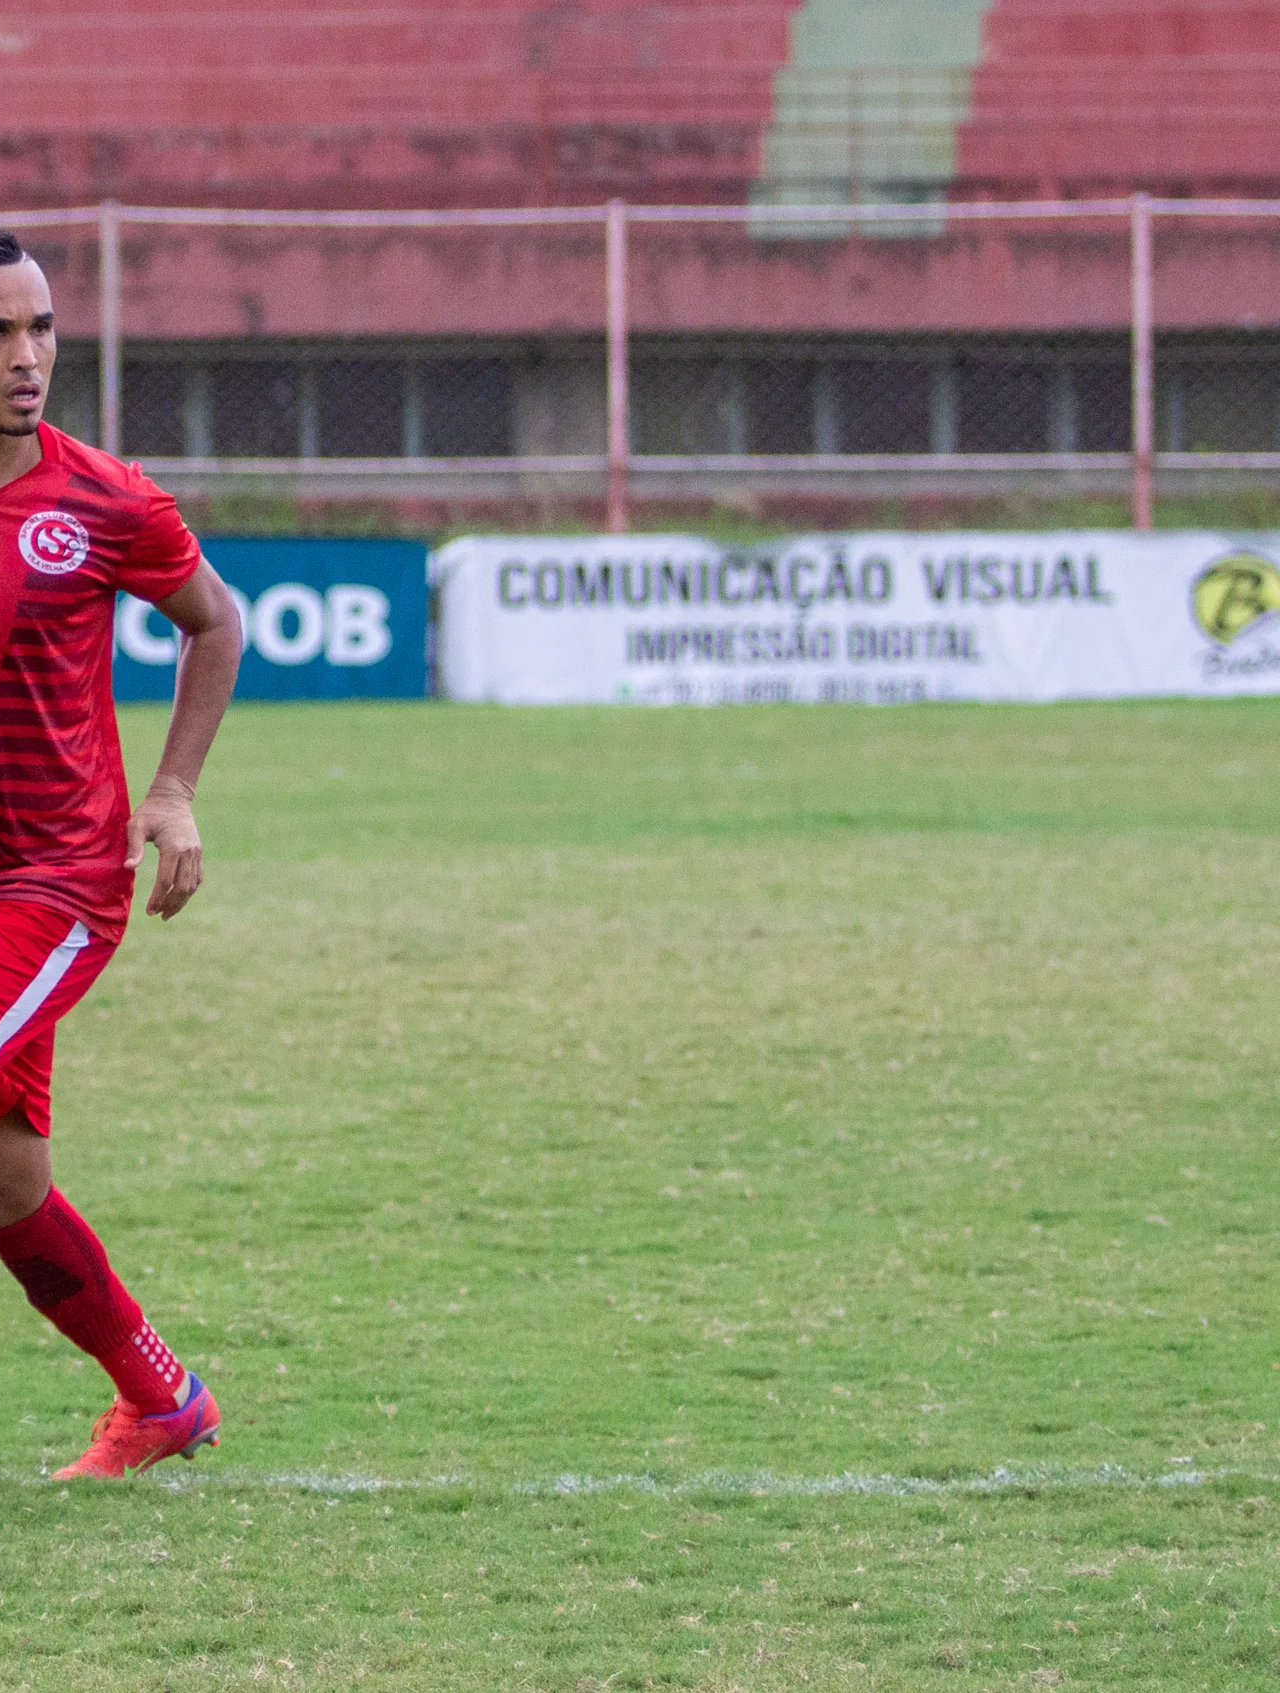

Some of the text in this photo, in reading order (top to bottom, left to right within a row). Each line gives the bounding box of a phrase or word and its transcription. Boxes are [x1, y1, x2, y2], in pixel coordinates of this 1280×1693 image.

[498, 549, 1114, 612] COMUNICAÇÃO VISUAL
[848, 625, 982, 665] DIGITAL
